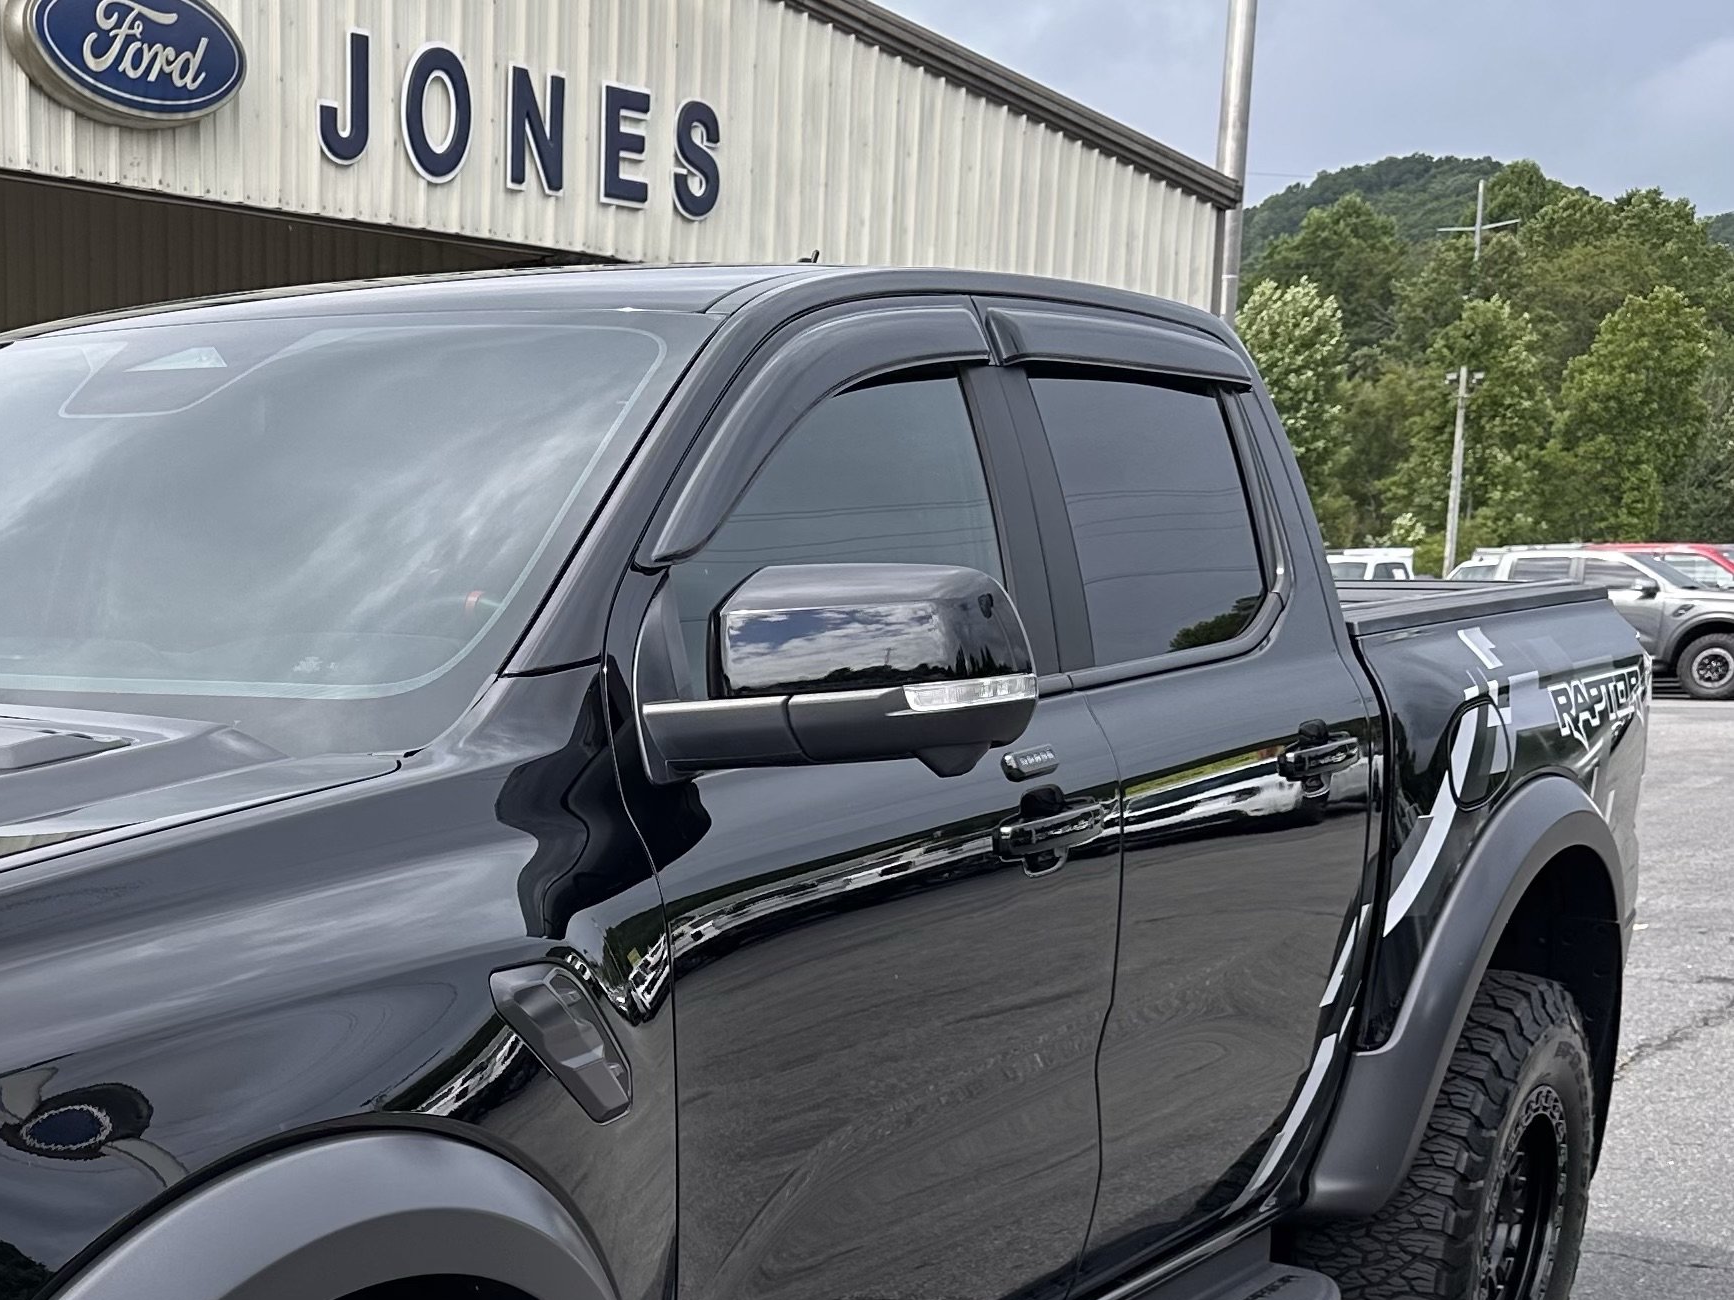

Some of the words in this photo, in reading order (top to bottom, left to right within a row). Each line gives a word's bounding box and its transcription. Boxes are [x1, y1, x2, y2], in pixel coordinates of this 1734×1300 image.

[82, 0, 208, 91] Ford
[316, 27, 721, 221] JONES
[1547, 665, 1644, 750] RAPTOR
